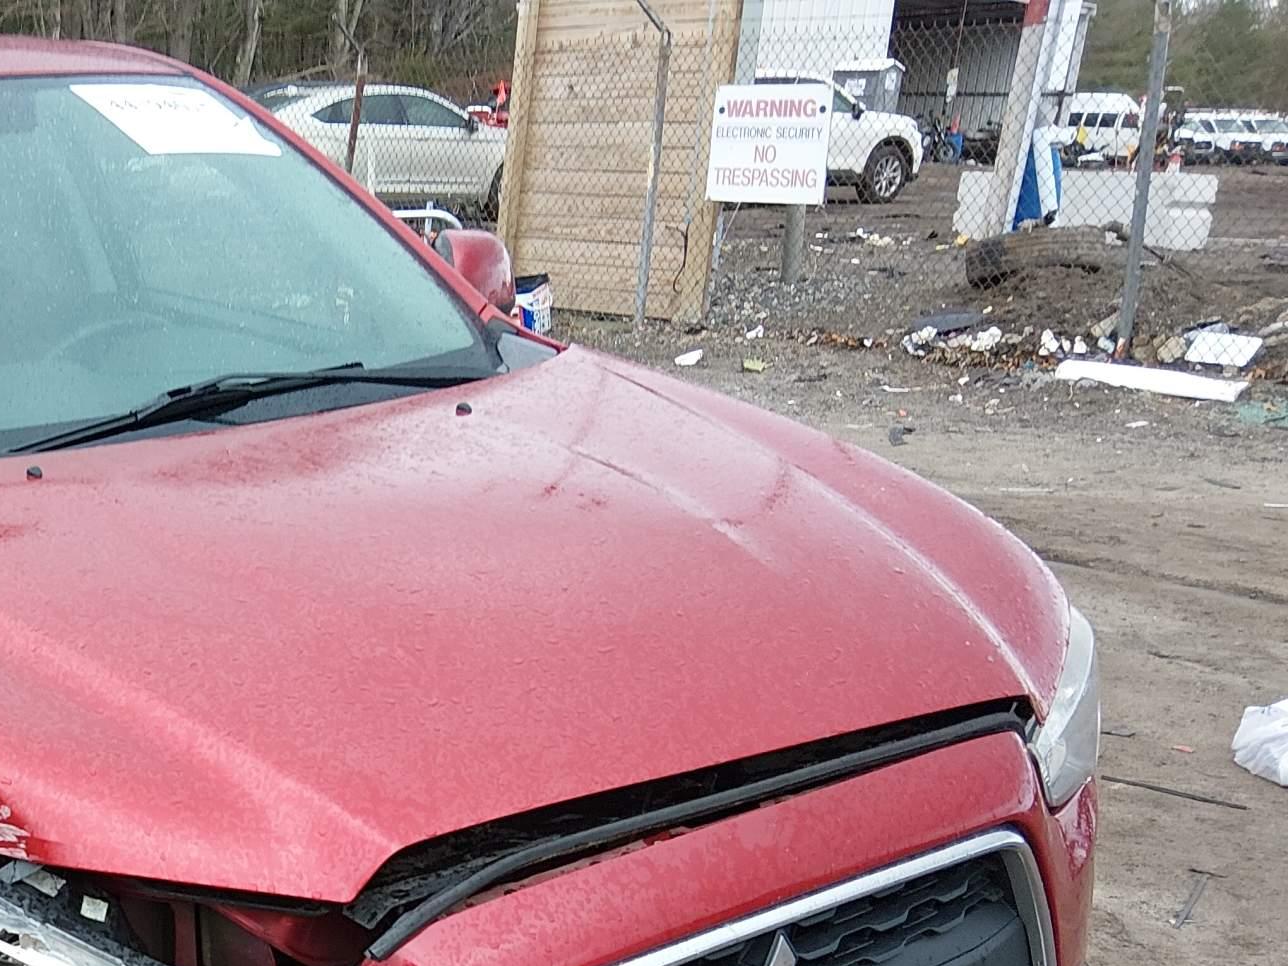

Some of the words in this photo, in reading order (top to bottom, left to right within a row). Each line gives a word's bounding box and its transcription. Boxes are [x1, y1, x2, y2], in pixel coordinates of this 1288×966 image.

[726, 99, 817, 118] WARNING
[716, 126, 772, 138] ELECTRONIC
[776, 127, 823, 139] SECURITY
[753, 145, 777, 163] NO
[714, 168, 817, 187] TRESPASSING
